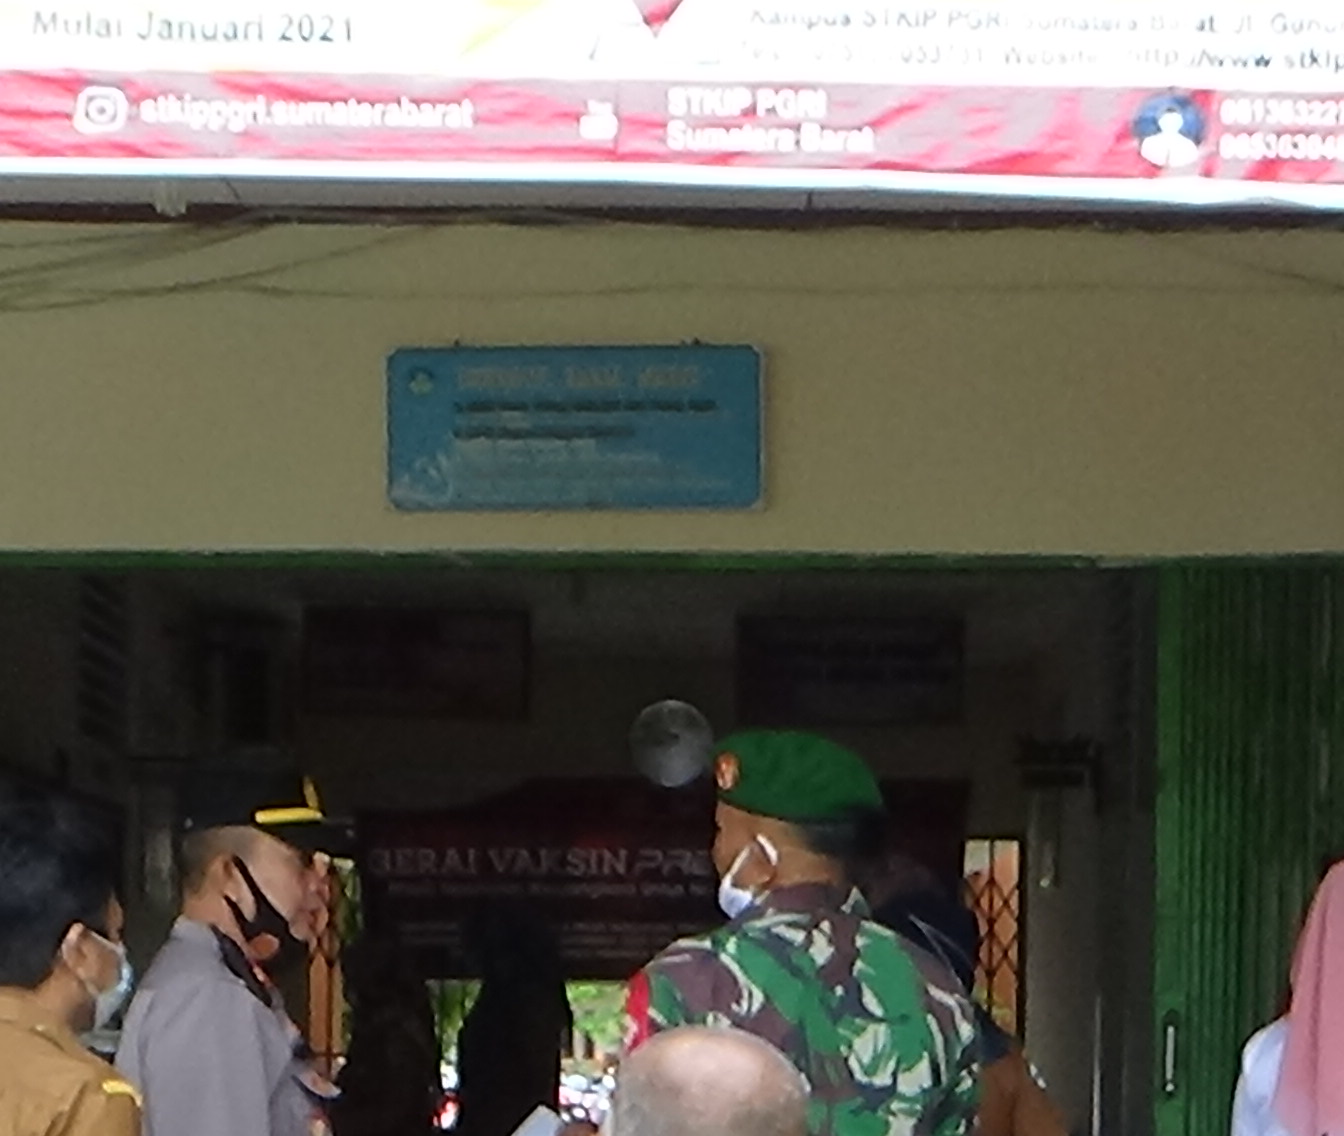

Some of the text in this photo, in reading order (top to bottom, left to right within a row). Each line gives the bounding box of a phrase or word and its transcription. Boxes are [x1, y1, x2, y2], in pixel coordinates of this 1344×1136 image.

[32, 10, 353, 44] Mulai Januari 2021
[667, 86, 827, 119] STKIP PGRI
[667, 119, 874, 152] Sumatera Barat
[367, 846, 477, 875] GERAI
[487, 847, 628, 876] VAKSIN
